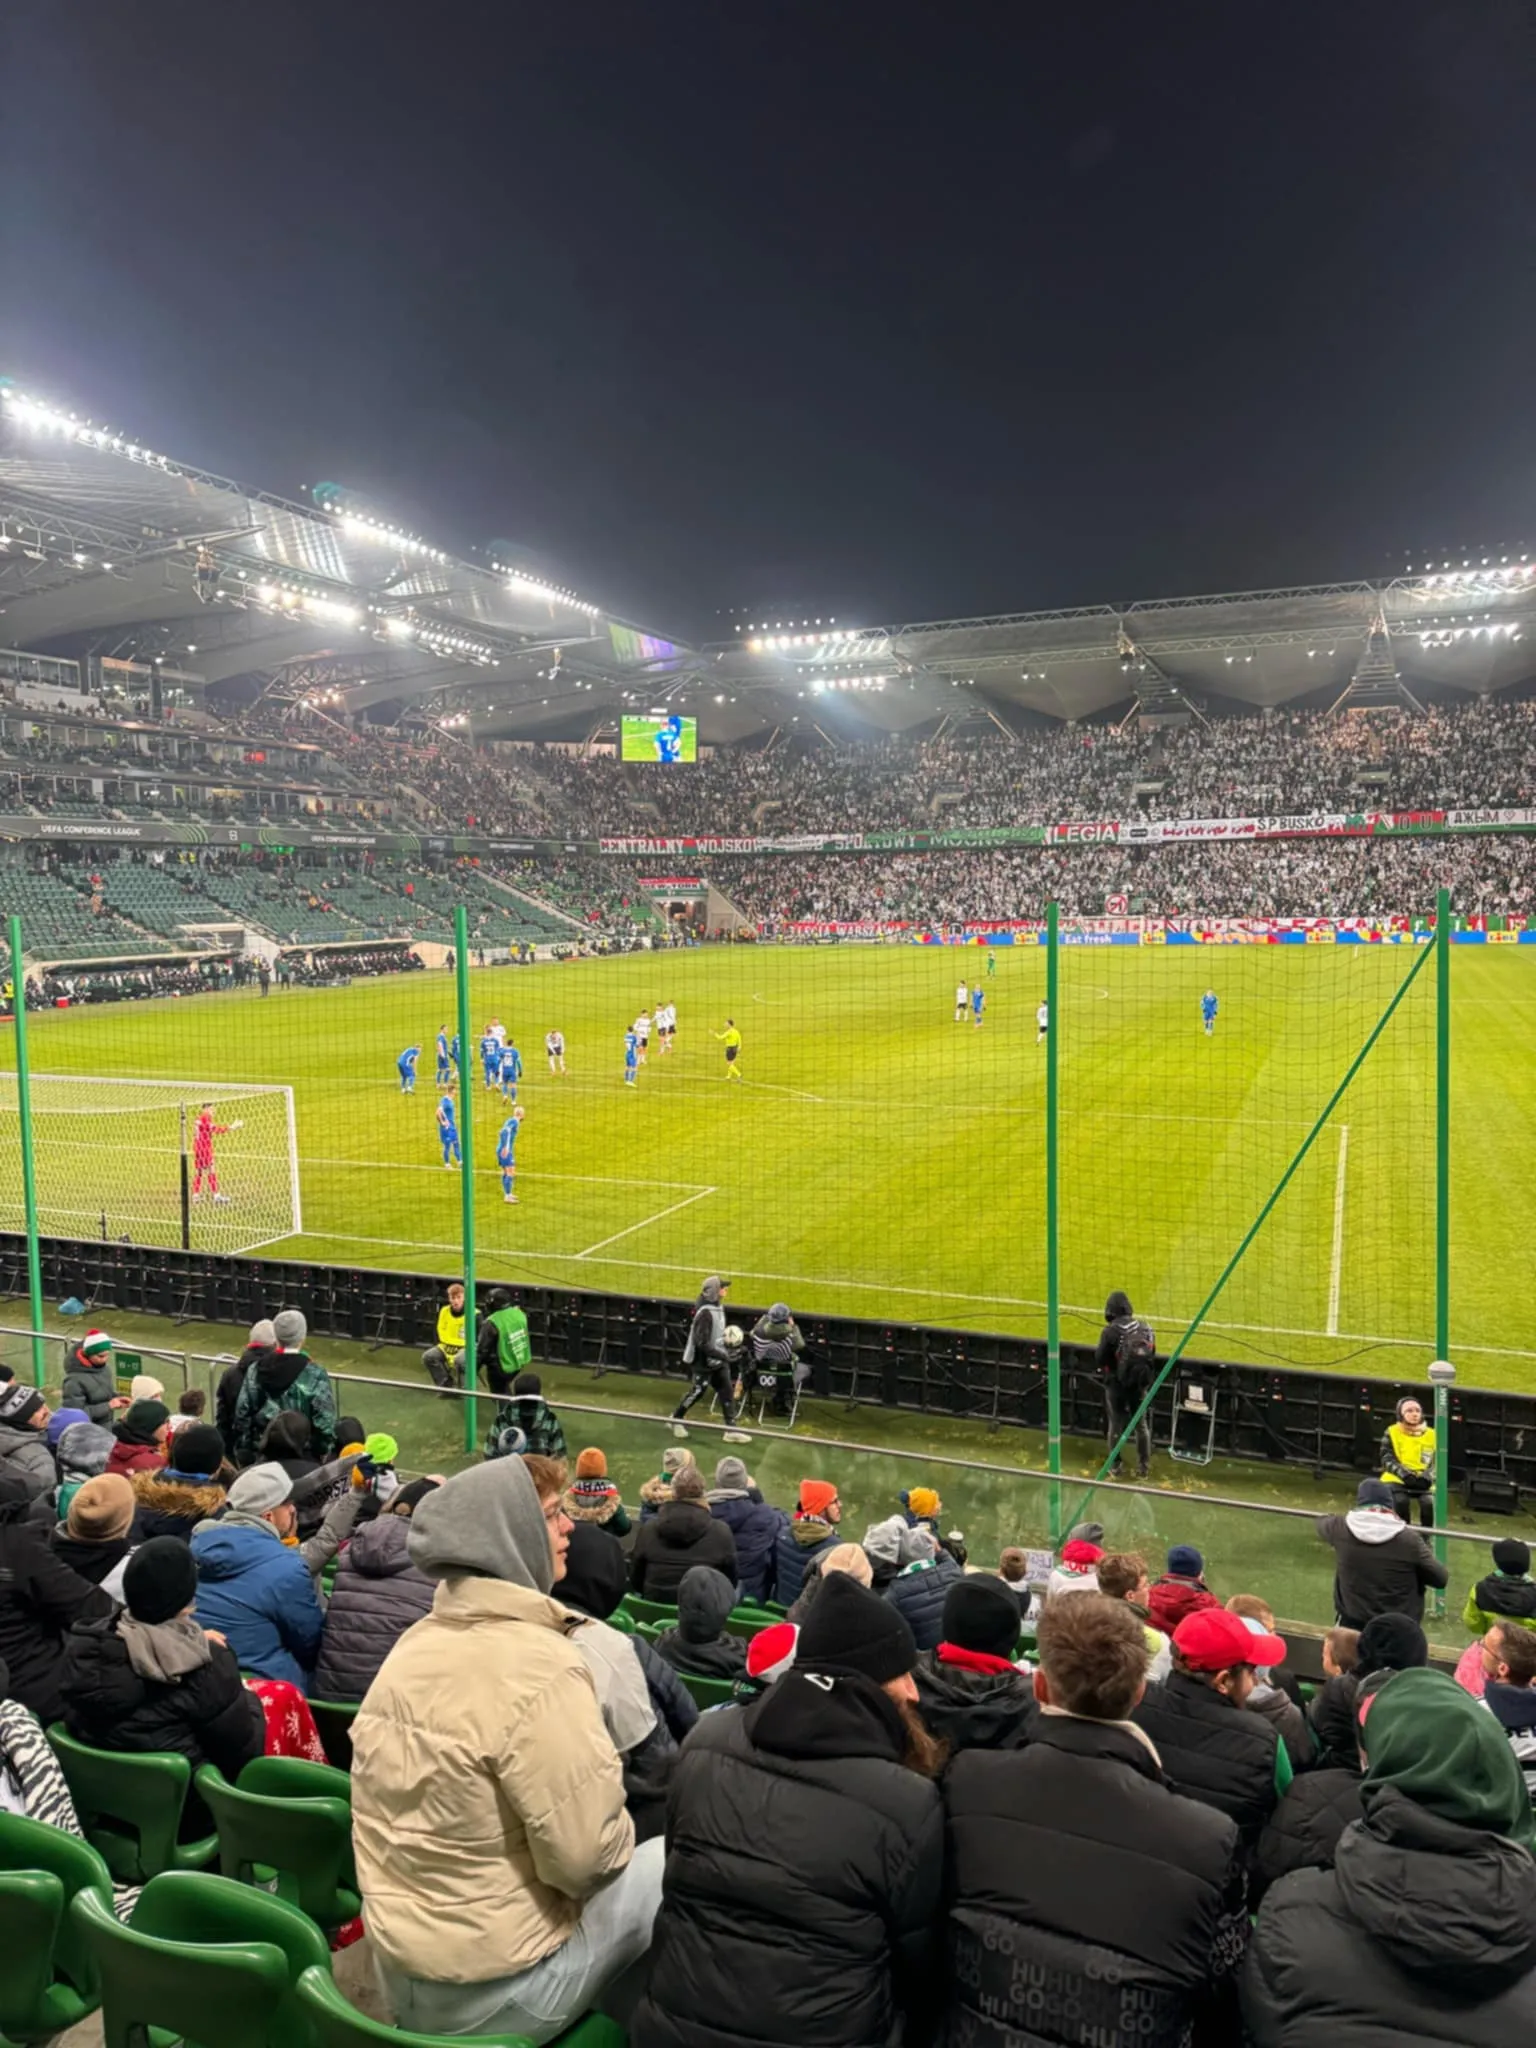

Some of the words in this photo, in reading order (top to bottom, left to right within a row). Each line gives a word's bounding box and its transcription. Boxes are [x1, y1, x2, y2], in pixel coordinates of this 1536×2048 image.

[41, 825, 61, 834] UEFA
[63, 826, 111, 836] CONFERENCE
[112, 827, 142, 837] LEAGUE
[1053, 823, 1117, 843] LEGIA
[600, 838, 684, 854] CENTRALNY
[982, 1930, 1015, 1956] GO
[1012, 1959, 1046, 1987] HU
[1085, 1959, 1122, 1984] GO
[1009, 1983, 1045, 2009] GO
[1120, 1987, 1155, 2011] HU
[1119, 2011, 1154, 2035] GO
